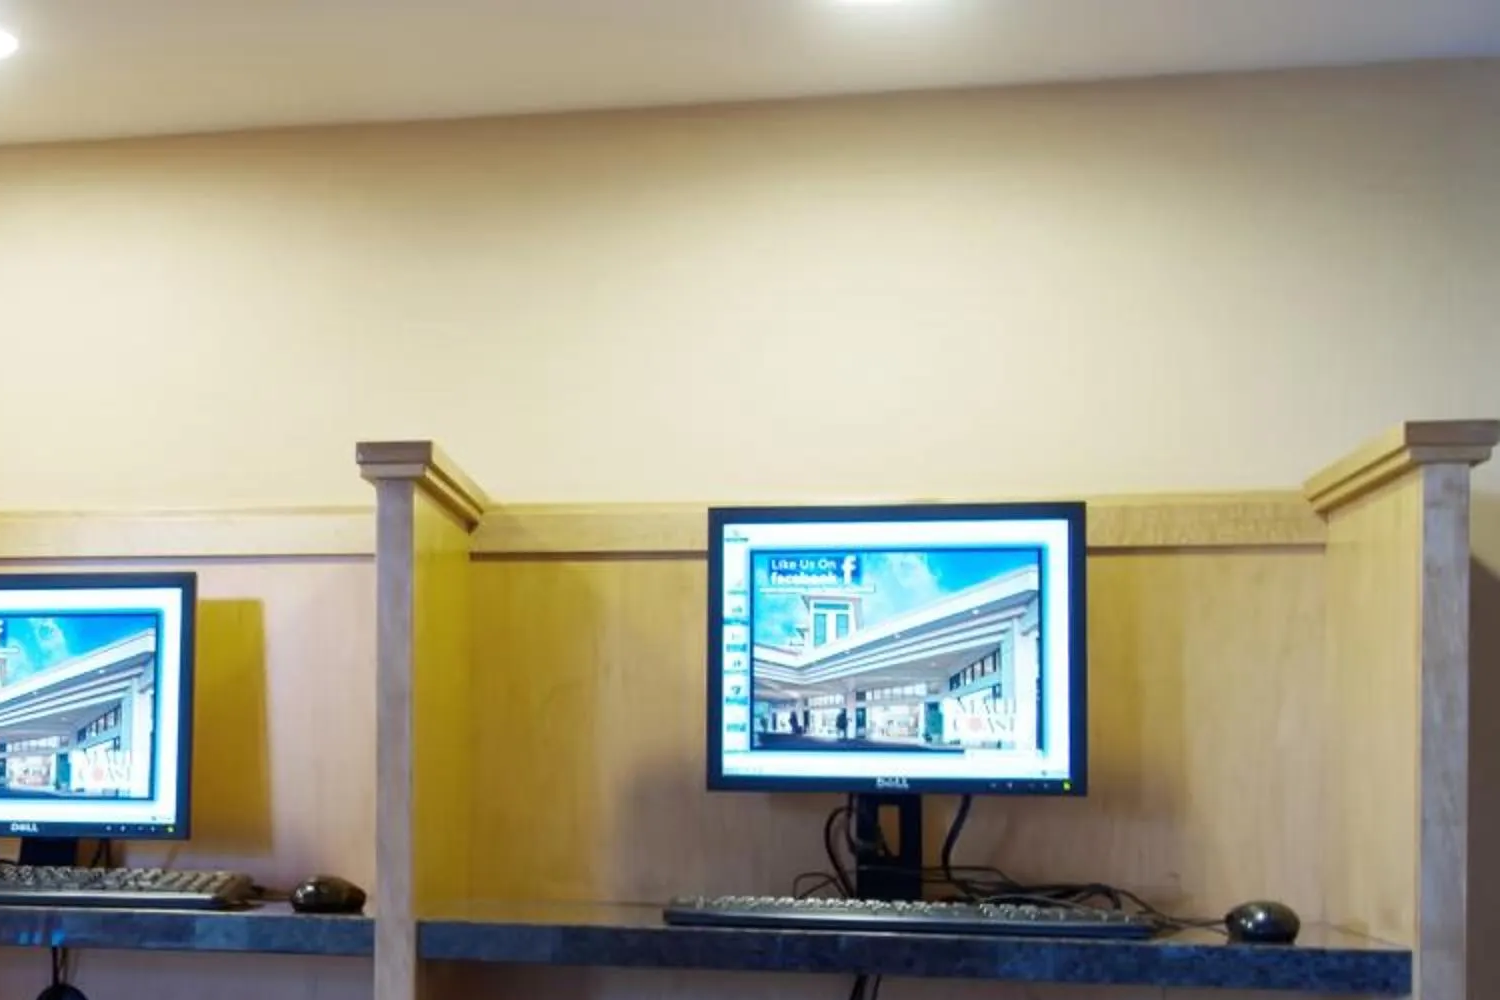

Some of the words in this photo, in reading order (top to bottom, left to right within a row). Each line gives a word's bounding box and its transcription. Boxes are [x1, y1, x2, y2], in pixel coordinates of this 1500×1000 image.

[771, 559, 797, 570] Like
[800, 559, 817, 570] Us
[818, 558, 837, 570] On
[10, 822, 39, 832] DELL
